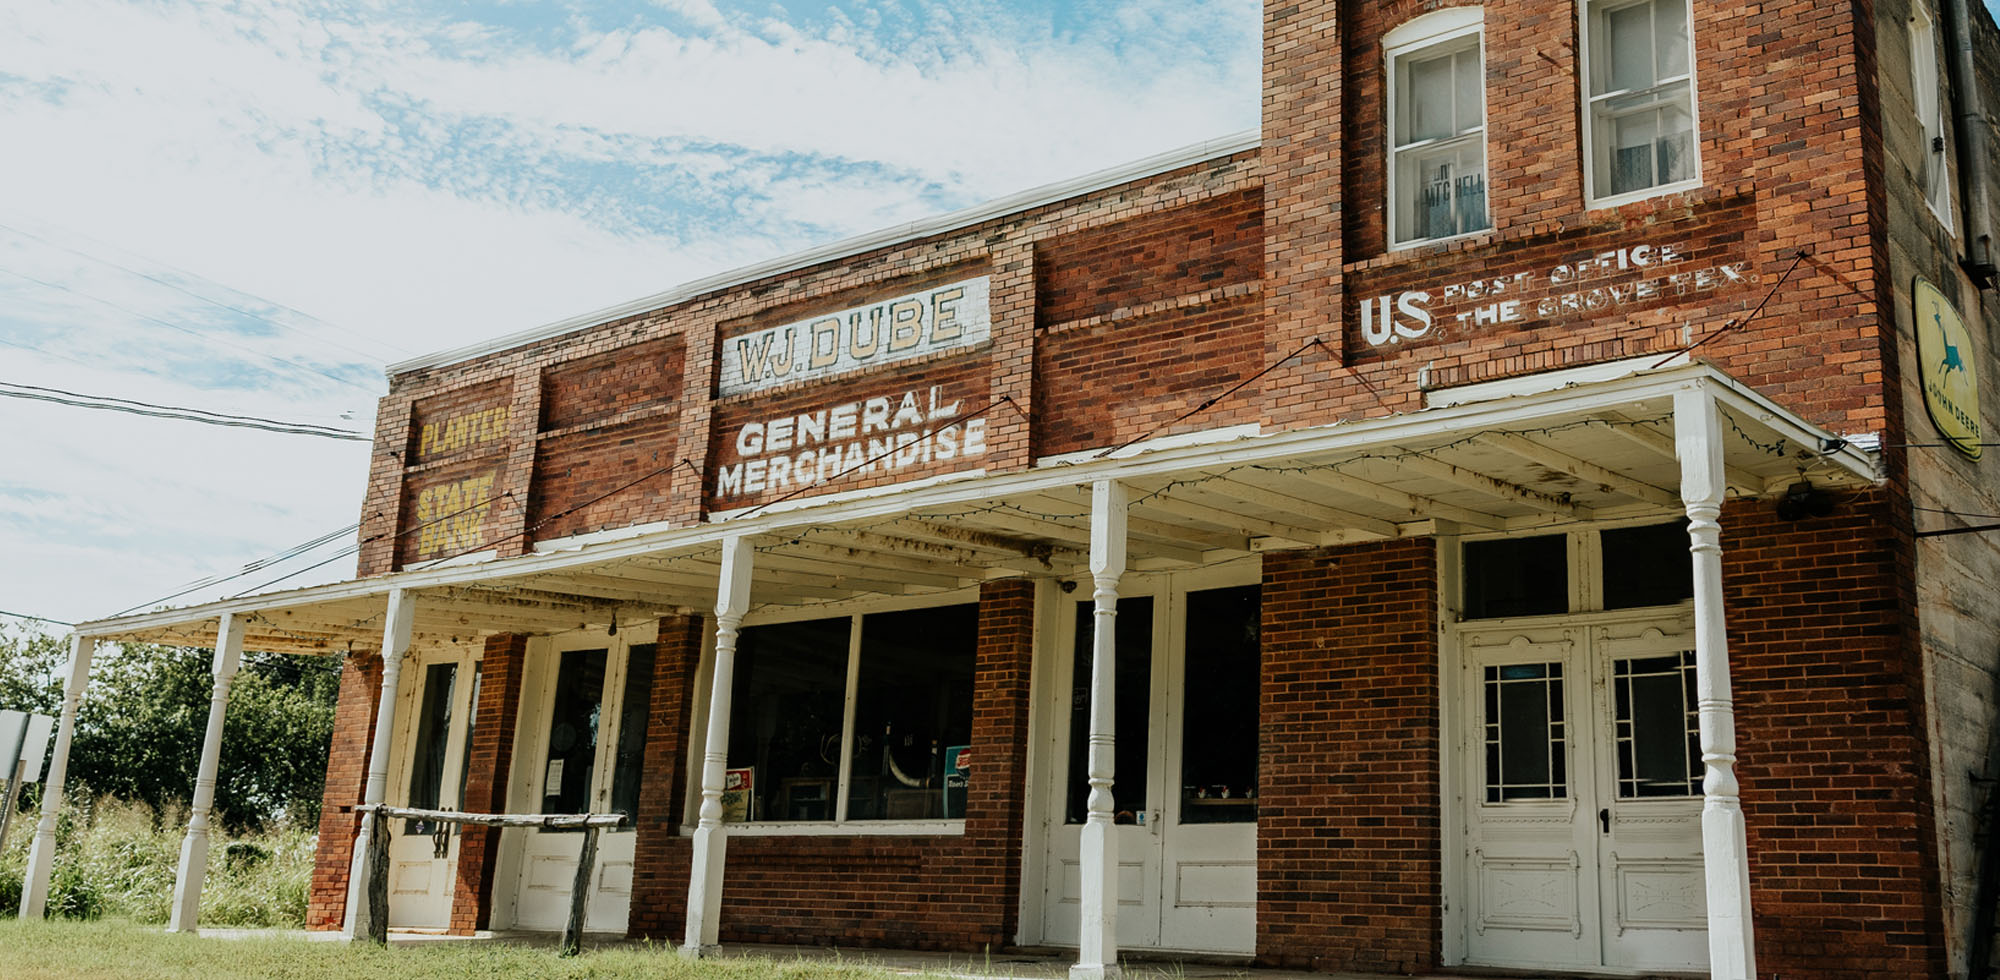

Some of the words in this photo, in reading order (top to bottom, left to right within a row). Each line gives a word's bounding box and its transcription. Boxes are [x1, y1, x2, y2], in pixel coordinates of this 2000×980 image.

[1444, 270, 1536, 305] POST
[1550, 241, 1685, 287] OFFICE
[1456, 299, 1528, 332] THE
[1537, 276, 1661, 319] GROVE
[808, 284, 968, 370] DUBE
[735, 384, 966, 457] GENERAL
[1928, 379, 1954, 416] JOHN
[1954, 404, 1980, 439] DEERE
[716, 417, 988, 498] MERCHANDISE
[416, 466, 498, 522] STATE
[417, 509, 487, 556] BANK
